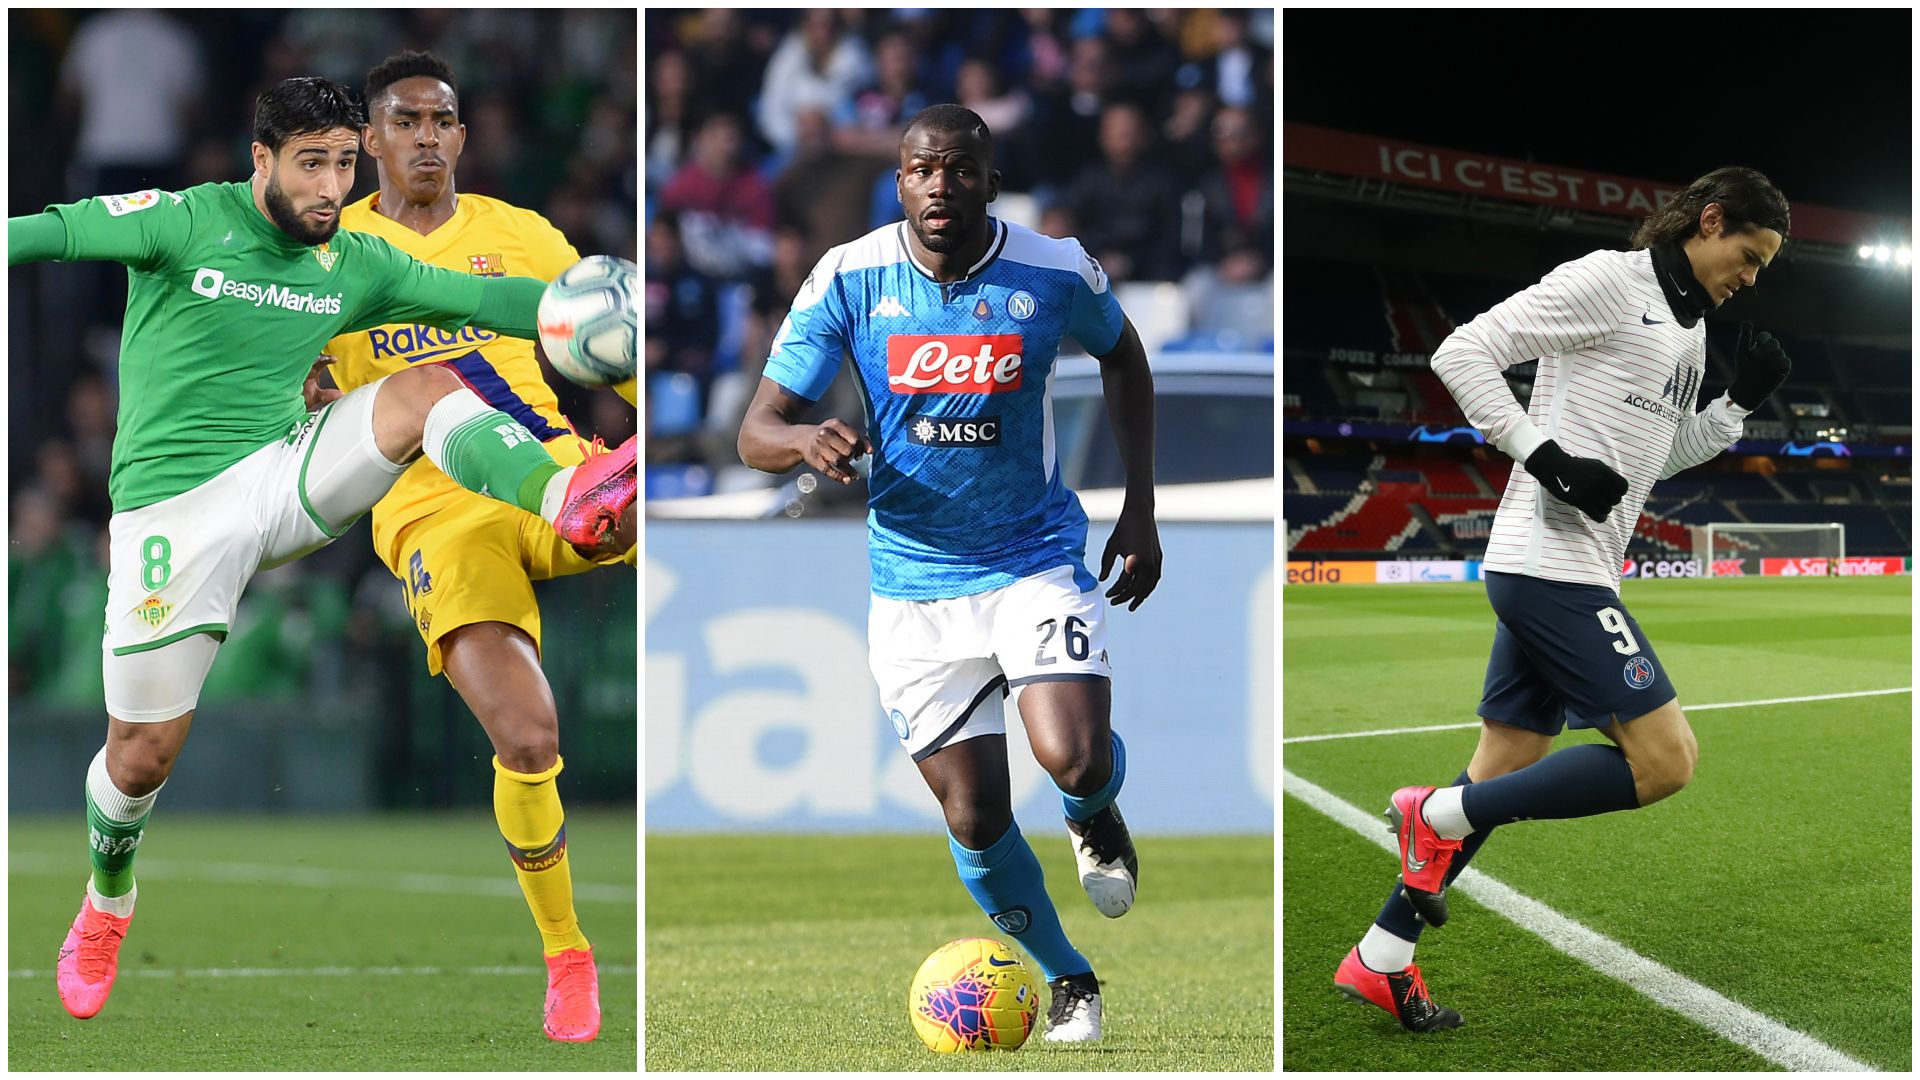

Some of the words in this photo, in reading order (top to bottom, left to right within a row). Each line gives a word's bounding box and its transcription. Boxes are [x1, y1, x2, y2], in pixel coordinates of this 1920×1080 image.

[1379, 145, 1441, 181] ICI
[1455, 159, 1583, 202] C'EST
[1596, 180, 1673, 213] PAR
[222, 280, 342, 314] easyMarkets
[368, 323, 494, 359] Rakute
[888, 340, 1022, 388] Lete
[938, 422, 996, 443] MSC
[140, 535, 172, 592] 8
[1800, 558, 1887, 576] Sanander
[1035, 615, 1089, 666] 26
[1596, 606, 1640, 656] 9
